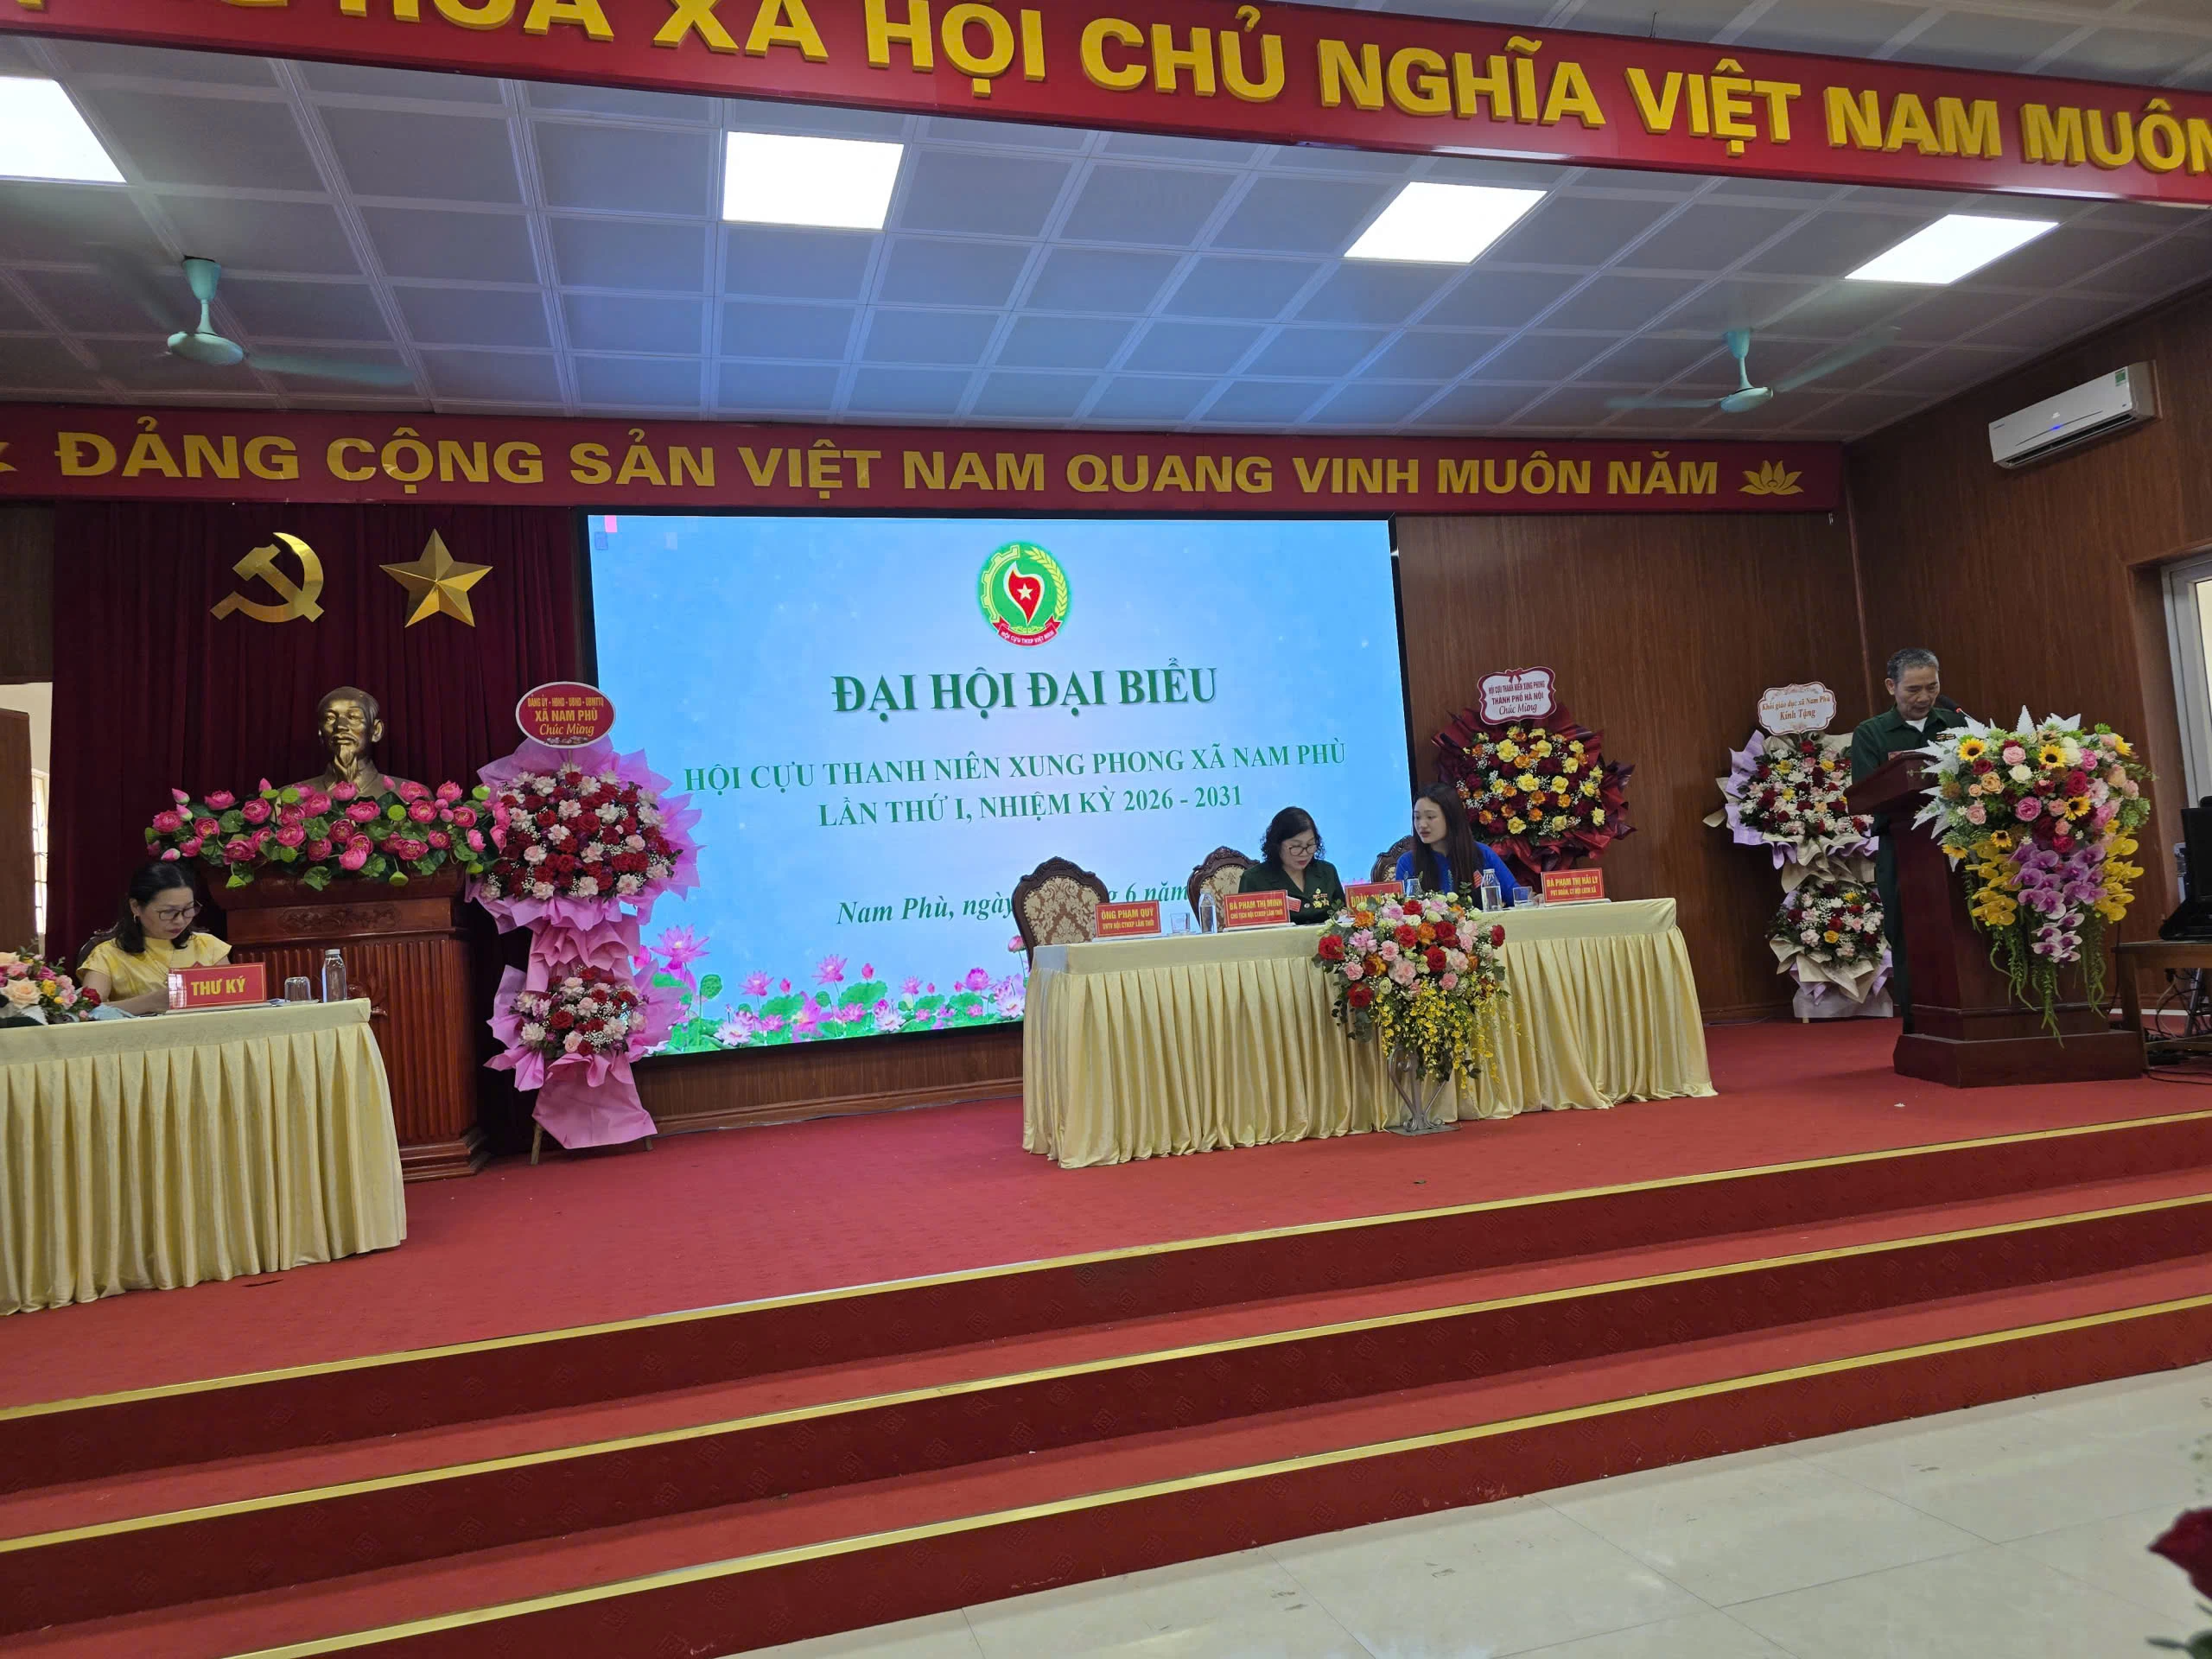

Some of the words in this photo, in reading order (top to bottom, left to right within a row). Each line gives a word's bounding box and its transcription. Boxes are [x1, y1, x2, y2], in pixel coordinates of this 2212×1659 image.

[1079, 5, 1285, 103] CHỦ
[1317, 35, 1606, 129] NGHĨA
[1624, 59, 1801, 157] VIỆT
[1824, 86, 2002, 159] NAM
[54, 416, 300, 480] ĐẢNG
[327, 427, 544, 494] CỘNG
[569, 428, 716, 486] SẢN
[738, 439, 881, 499] VIỆT
[903, 450, 1045, 492] NAM
[1066, 453, 1274, 494] QUANG
[1292, 456, 1419, 494] VINH
[1437, 451, 1591, 495] MUÔN
[1607, 450, 1718, 495] NĂM
[830, 673, 918, 721] ĐẠI
[928, 667, 1016, 719] HỘI
[1026, 670, 1107, 716] ĐẠI
[1116, 657, 1217, 704] BIỂU
[1491, 695, 1510, 705] THÀNH
[1524, 690, 1532, 701] HÀ
[1534, 690, 1544, 701] NỘI
[535, 709, 549, 721] XÃ
[551, 709, 575, 721] NAM
[578, 707, 598, 721] PHÙ
[1499, 704, 1516, 715] Chúc
[1780, 709, 1796, 721] Kính
[1798, 709, 1815, 720] Tặng
[539, 723, 563, 735] Chúc
[683, 764, 741, 795] HỘI
[751, 761, 816, 793] CỰU
[823, 760, 926, 785] THANH
[933, 751, 1001, 780] NIÊN
[1008, 753, 1085, 778] XUNG
[1092, 749, 1183, 774] PHONG
[1190, 743, 1226, 770] XÃ
[1233, 745, 1289, 768] NAM
[1296, 738, 1346, 765] PHÙ
[818, 797, 877, 826] LẦN
[885, 792, 949, 823] THỨ
[955, 798, 972, 823] I,
[980, 791, 1071, 821] NHIỆM
[1078, 785, 1116, 813] KỲ
[1123, 787, 1173, 811] 2026
[1195, 785, 1243, 808] 2031
[1546, 878, 1554, 887] BÀ
[1572, 877, 1581, 887] THỊ
[1592, 875, 1599, 884] LY
[836, 901, 893, 925] Nam
[900, 889, 955, 922] Phù,
[963, 891, 1013, 921] ngày
[1125, 882, 1137, 902] 6
[1144, 880, 1188, 902] năm
[1229, 899, 1237, 911] BÀ
[1238, 899, 1256, 911] PHẠM
[1256, 899, 1267, 910] THỊ
[1267, 898, 1282, 907] MINH
[1101, 909, 1116, 920] ÔNG
[1117, 908, 1139, 920] PHẠM
[190, 978, 222, 996] THƯ
[226, 975, 246, 994] KÝ
